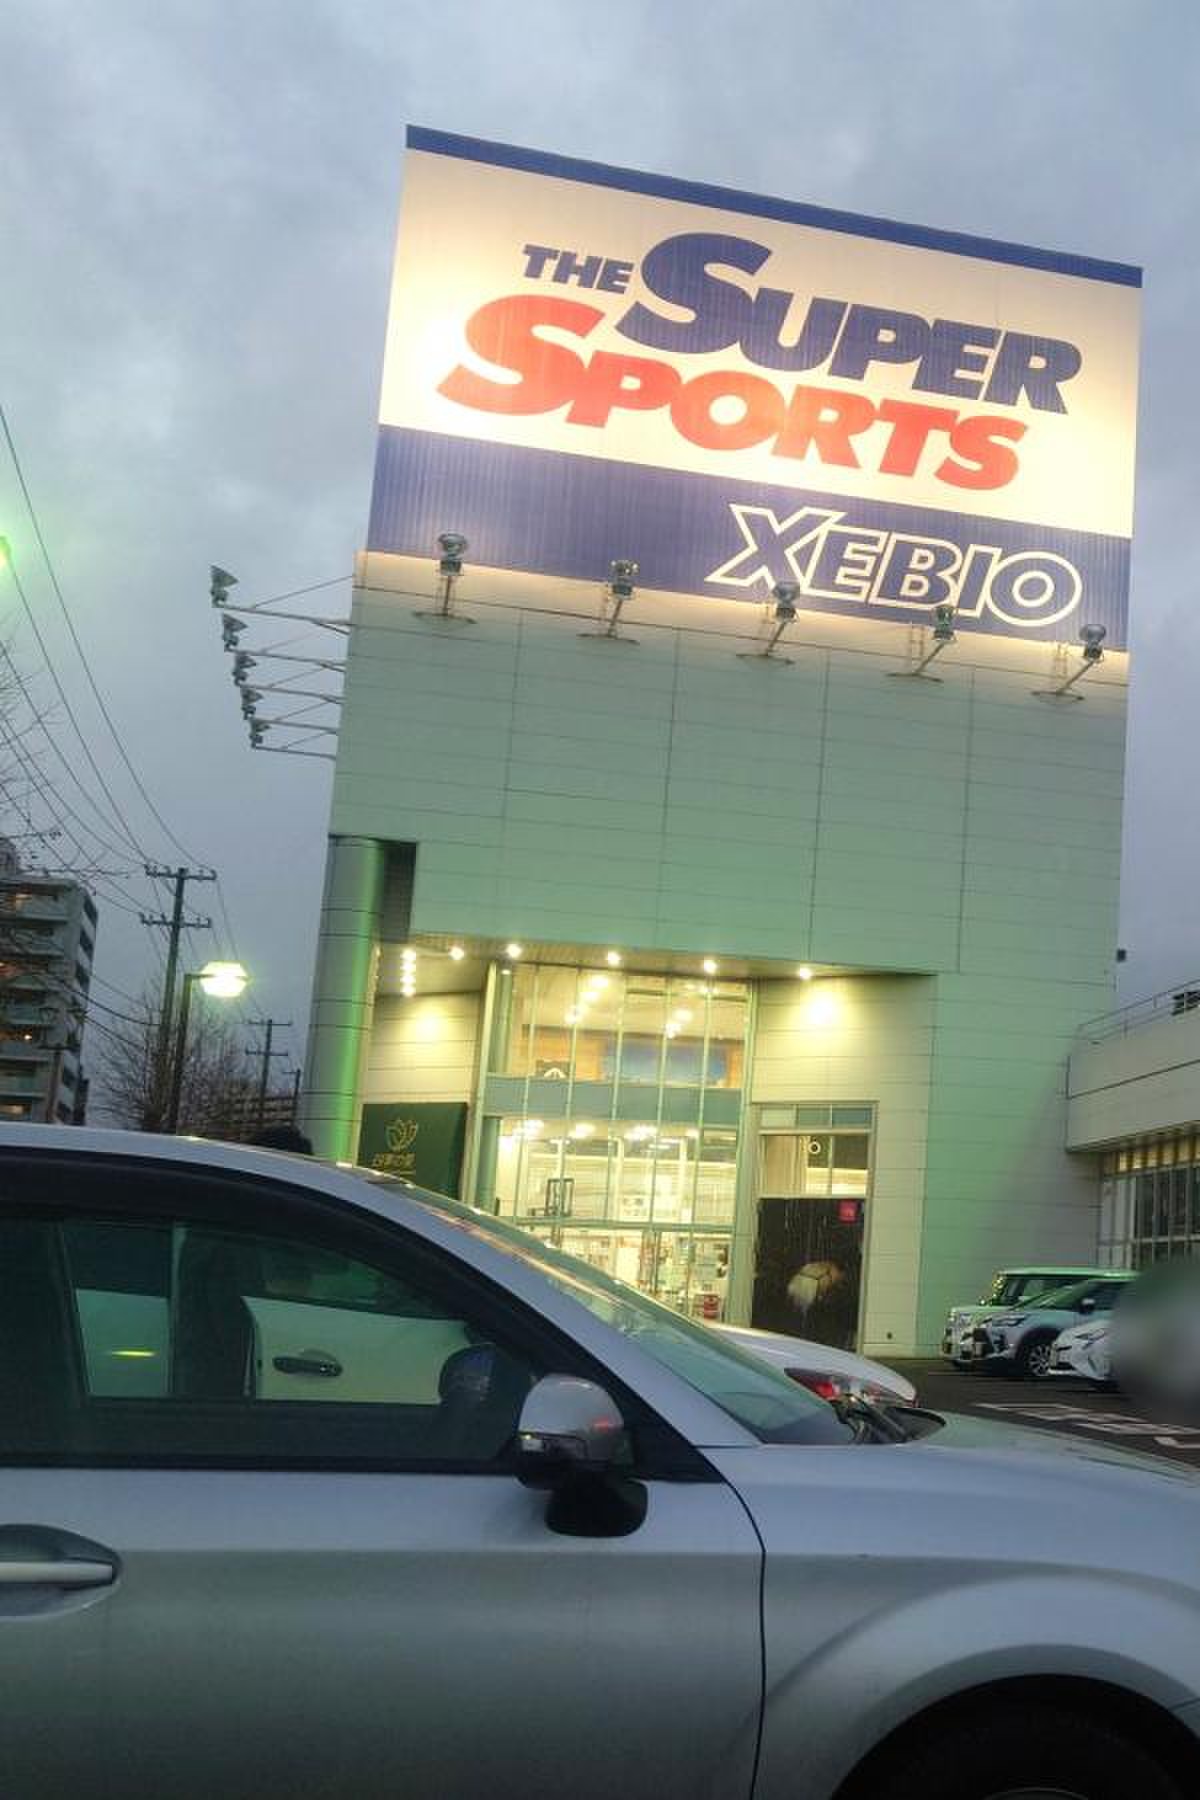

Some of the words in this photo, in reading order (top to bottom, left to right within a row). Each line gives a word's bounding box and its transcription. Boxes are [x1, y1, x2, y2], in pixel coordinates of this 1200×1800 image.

[436, 294, 1029, 490] SPORTS
[522, 243, 634, 295] THE
[615, 232, 1082, 414] SUPER
[707, 504, 1084, 626] XEBIO
